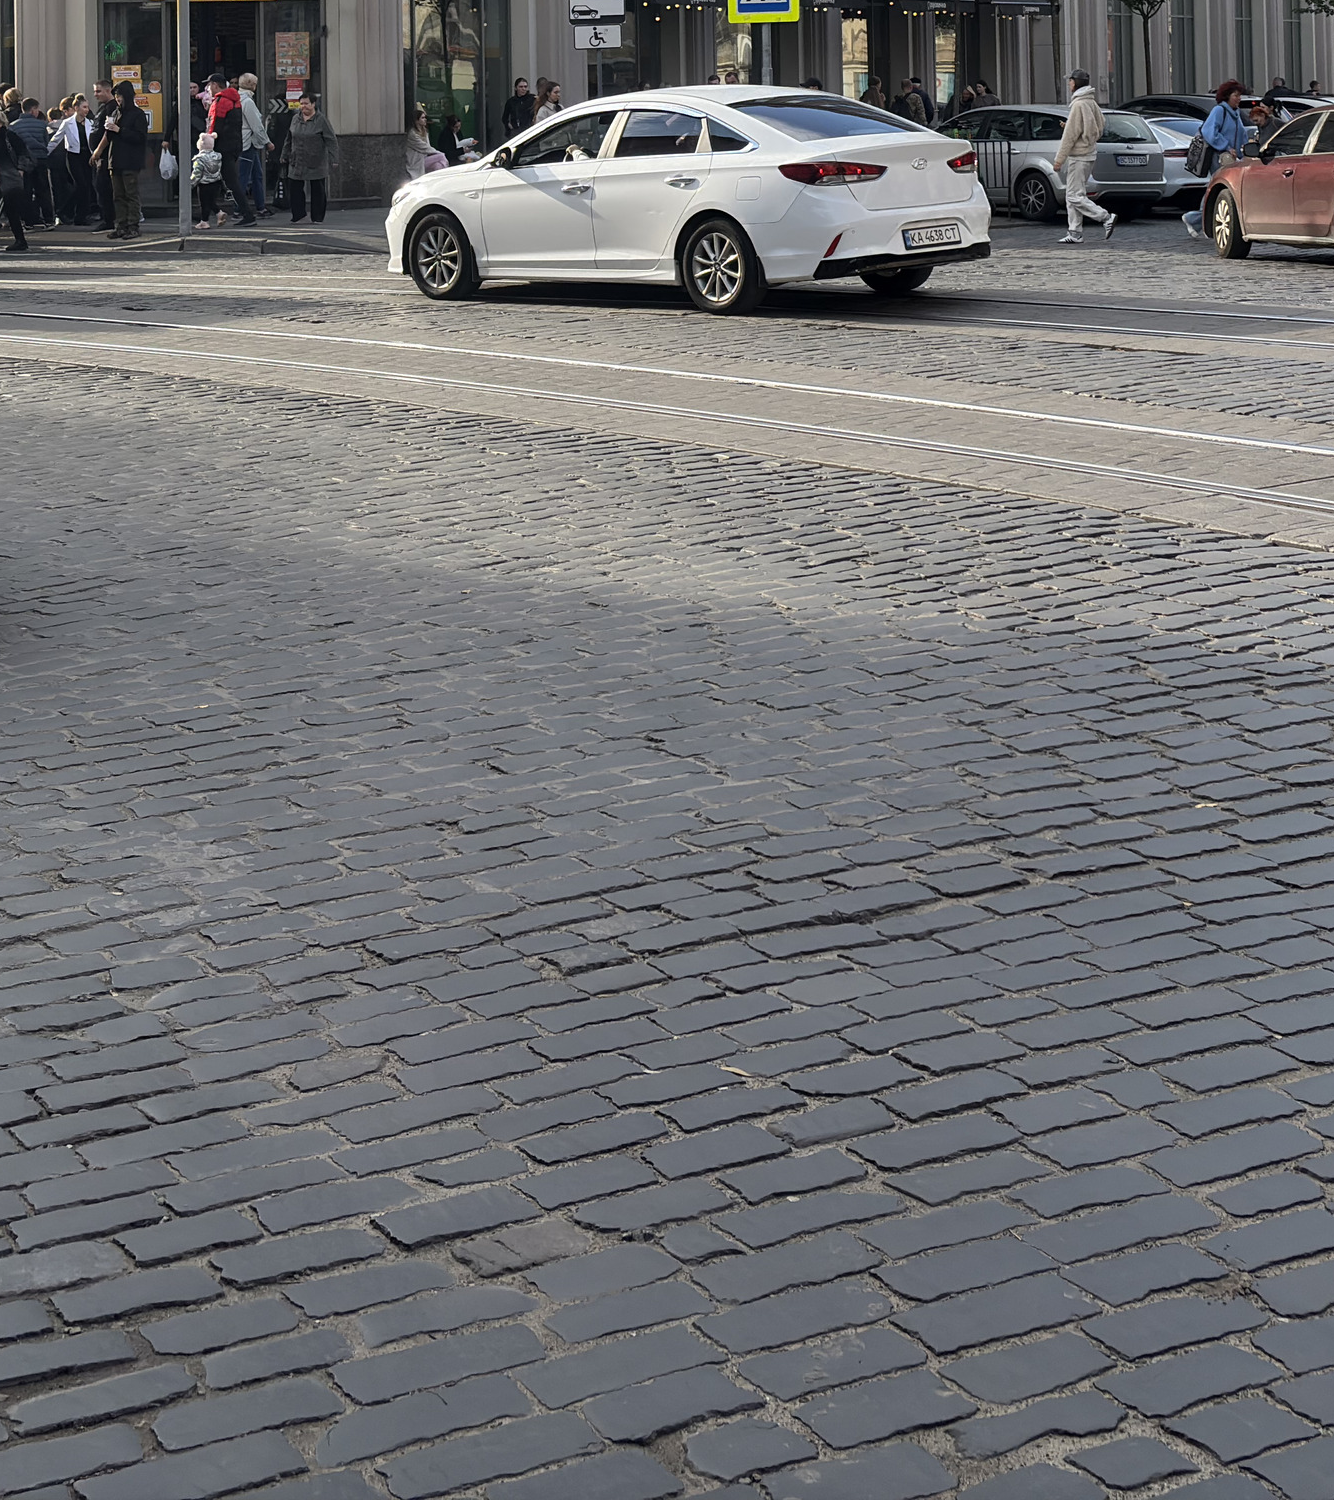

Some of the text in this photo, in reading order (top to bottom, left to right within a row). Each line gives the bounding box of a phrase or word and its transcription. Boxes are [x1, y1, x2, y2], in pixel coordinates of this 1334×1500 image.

[909, 227, 956, 245] KA 4638 CT
